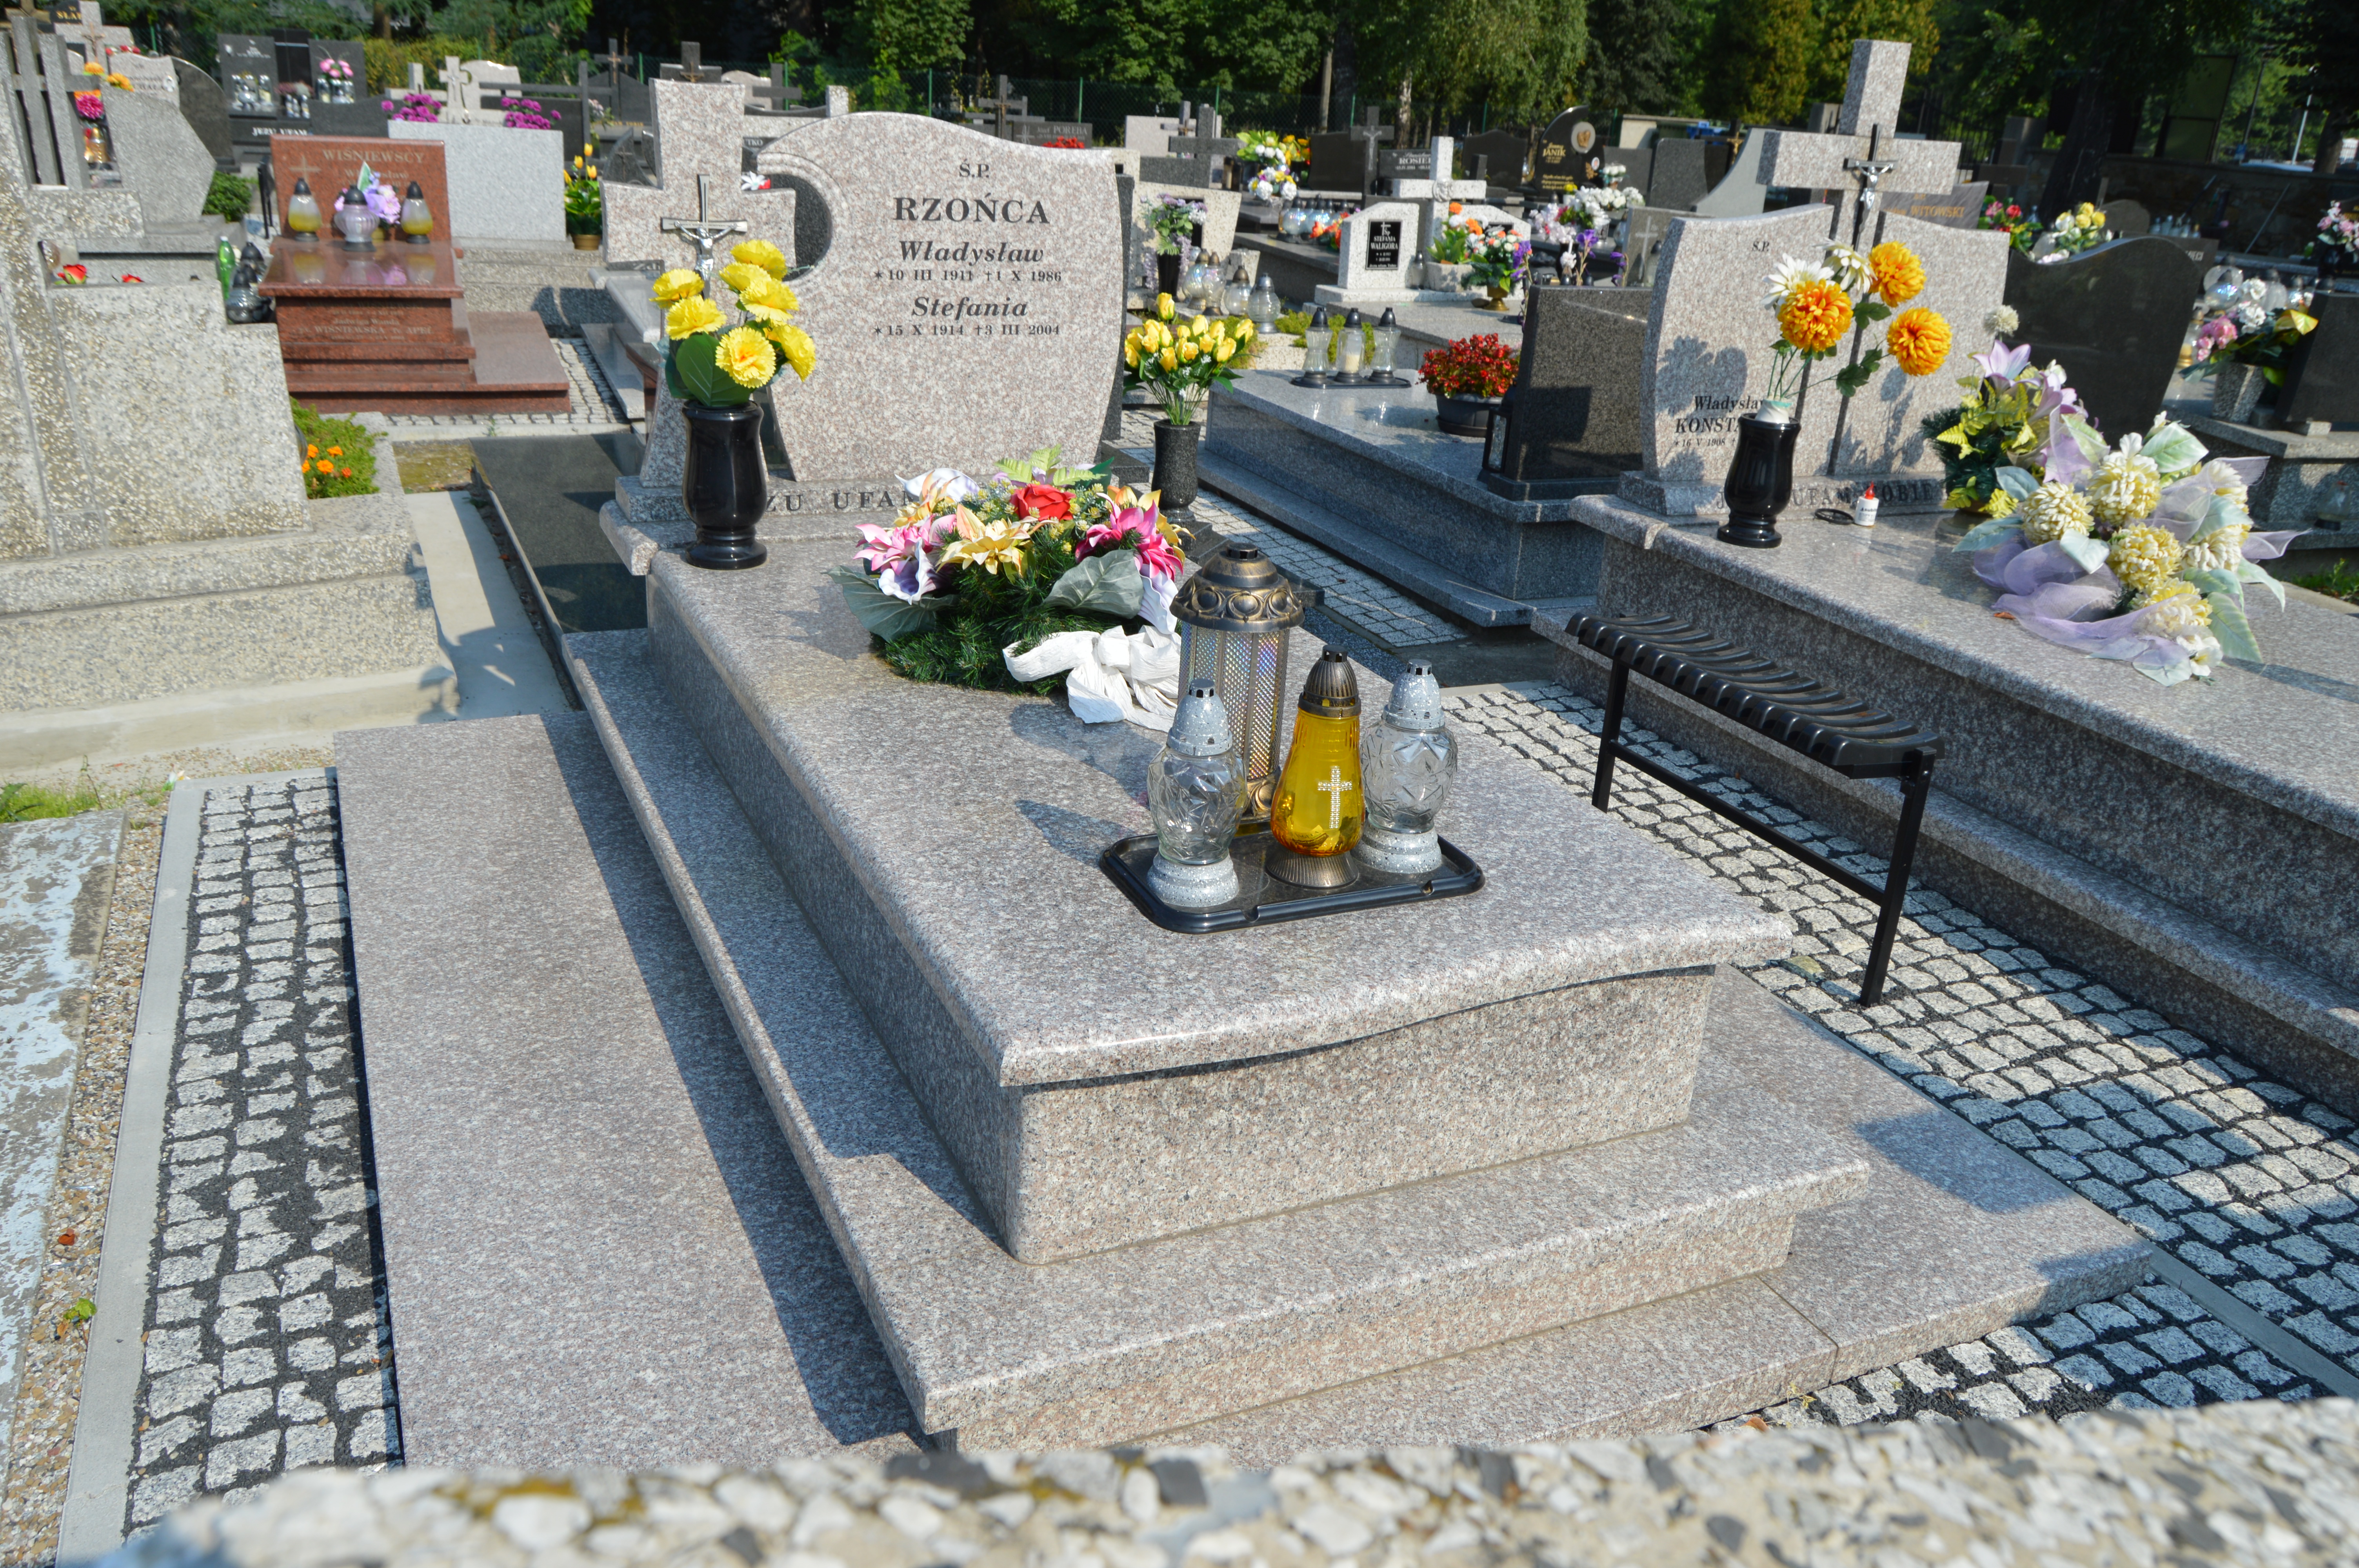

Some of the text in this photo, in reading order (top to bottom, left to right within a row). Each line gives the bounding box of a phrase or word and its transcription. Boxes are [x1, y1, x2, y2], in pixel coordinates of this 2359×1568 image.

[322, 147, 424, 163] WIŚNIEWSCY
[1543, 149, 1566, 157] JANIK
[959, 159, 990, 178] Ś.P.
[893, 192, 1050, 224] RZOŃCA
[1910, 205, 1965, 218] WITOWSKI
[900, 241, 1043, 266] Władysław
[889, 269, 904, 280] 10
[914, 269, 932, 281] III
[941, 270, 973, 281] 1911
[1011, 270, 1021, 281] X
[1032, 271, 1062, 282] 1986
[911, 297, 1028, 321] Stefania
[314, 324, 386, 334] WIŚNIEWSKA
[888, 325, 903, 336] 15
[912, 324, 922, 336] X
[933, 325, 963, 336] 1914
[1002, 324, 1020, 335] III
[1029, 325, 1059, 335] 2004
[1682, 438, 1725, 447] 16 V 1908
[1870, 482, 1935, 503] OBIE
[766, 494, 803, 512] ZU
